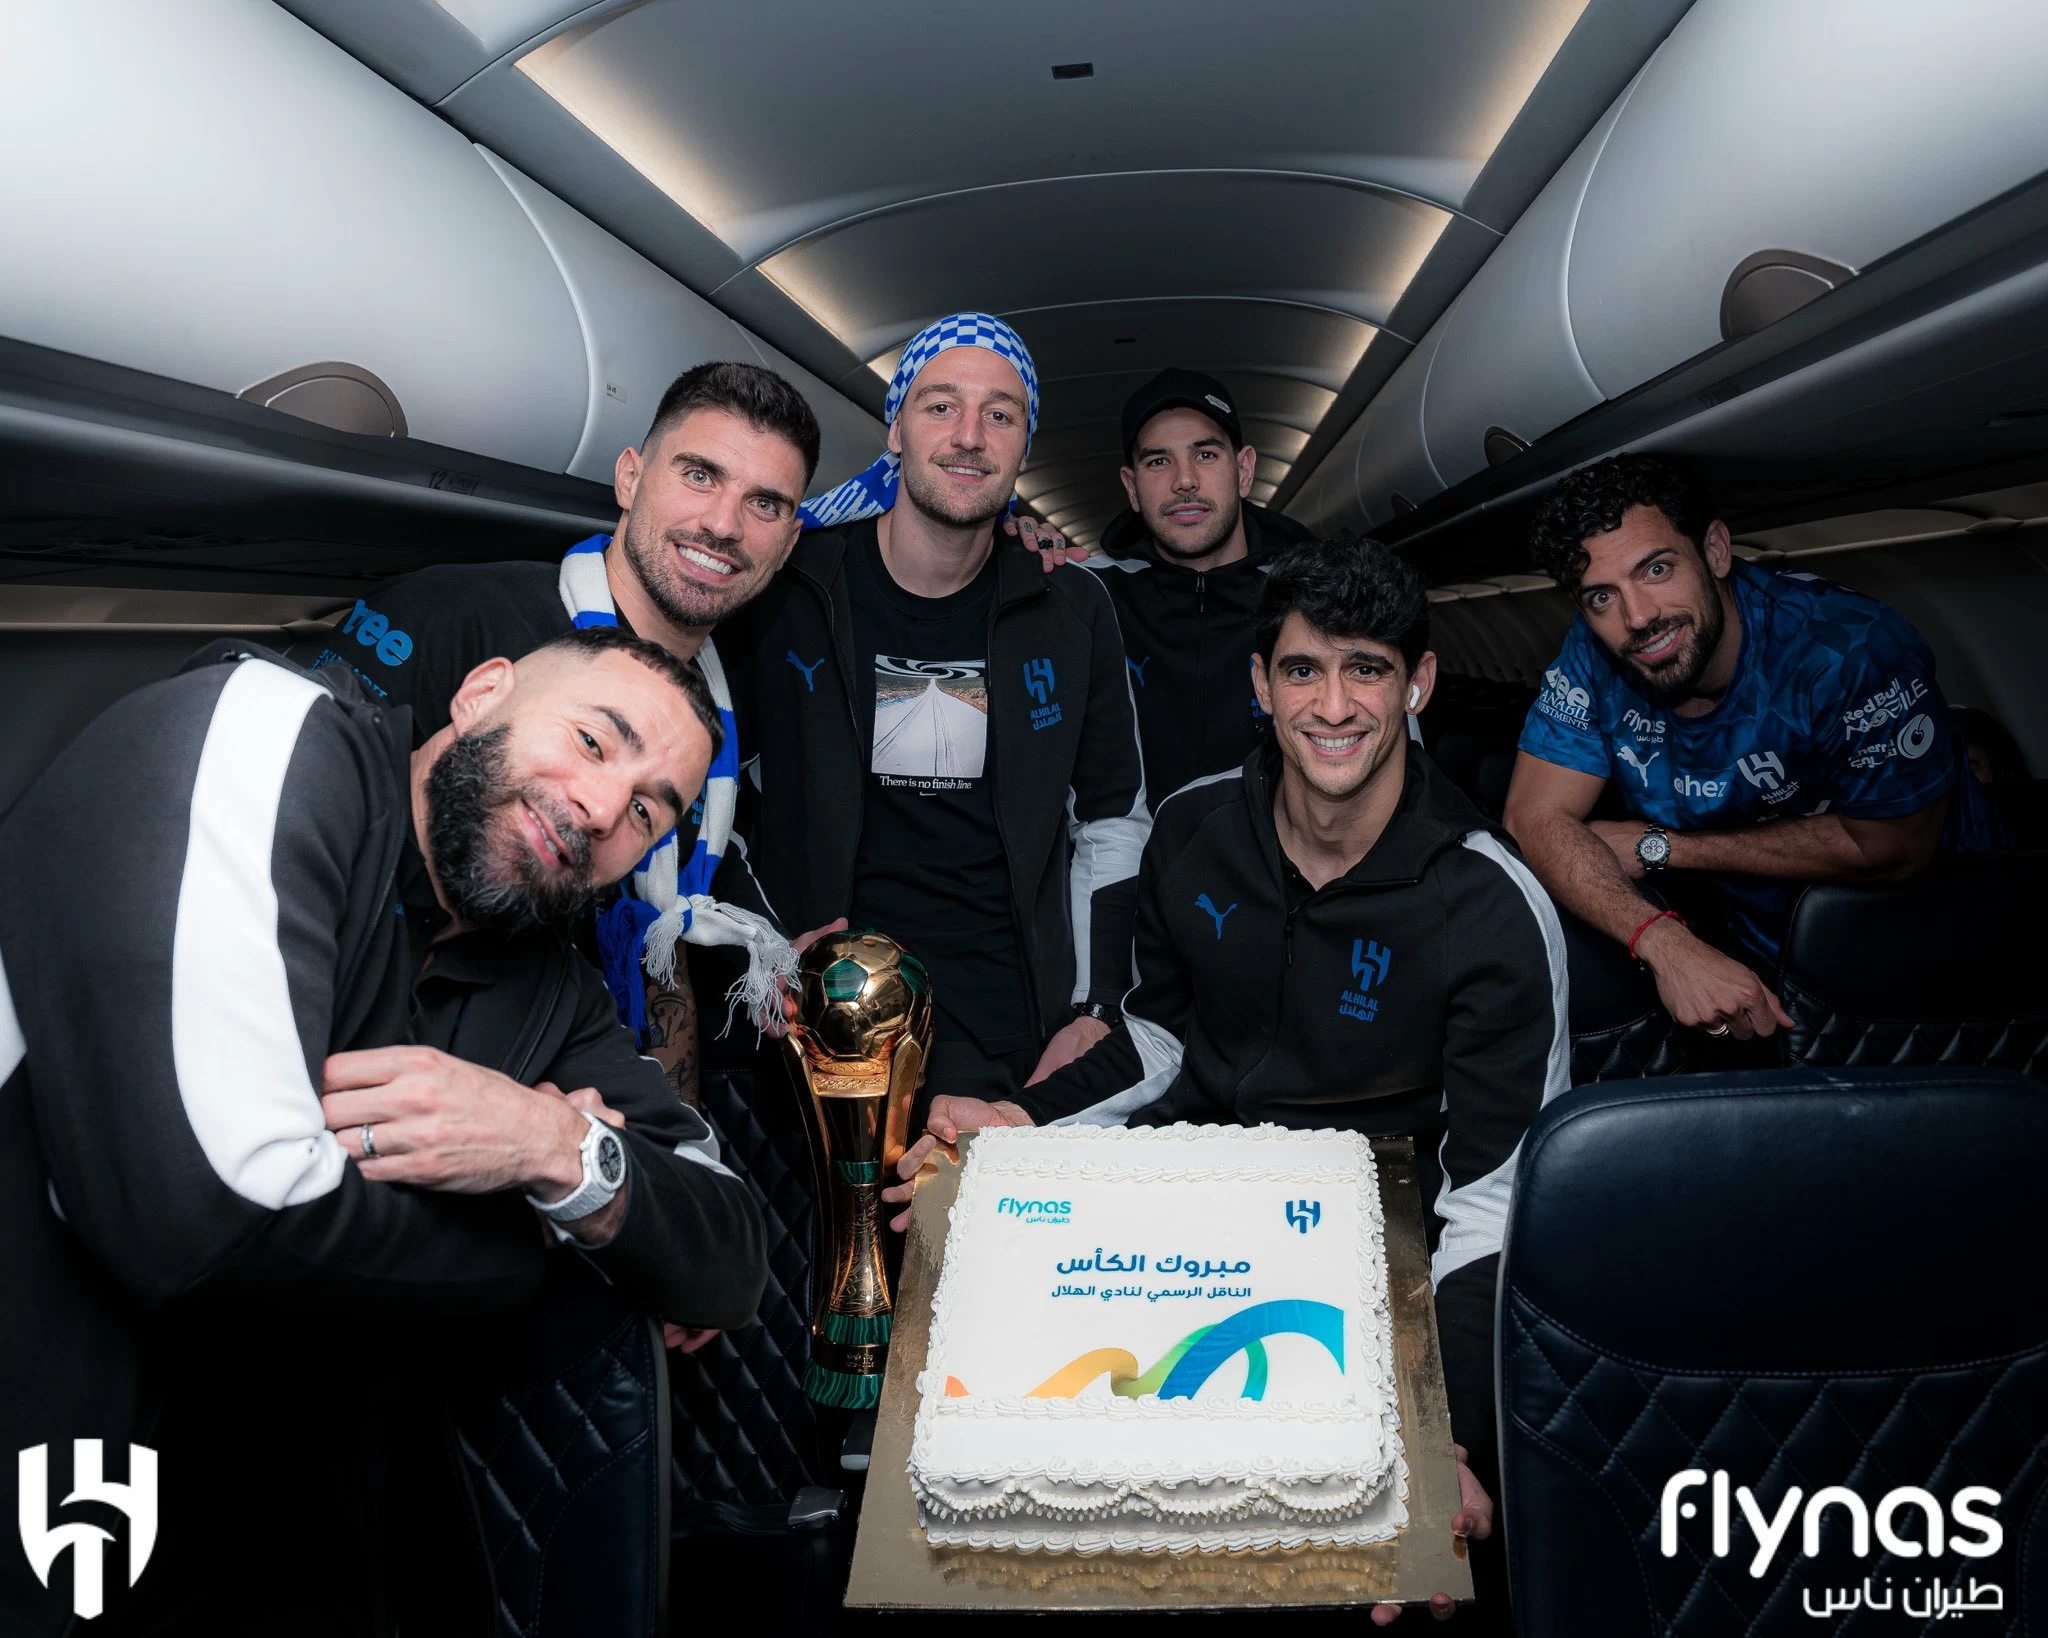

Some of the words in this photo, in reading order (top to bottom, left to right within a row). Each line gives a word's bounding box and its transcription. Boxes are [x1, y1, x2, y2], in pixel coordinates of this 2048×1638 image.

[1843, 698, 1877, 724] Red
[1874, 677, 1901, 707] Bull
[880, 775, 907, 786] There
[908, 778, 917, 787] is
[918, 780, 931, 789] no
[932, 778, 957, 790] finish
[1341, 989, 1379, 1012] ALHILAL
[997, 1197, 1072, 1218] flynas
[1056, 1247, 1146, 1275] الكأس
[1155, 1254, 1251, 1278] مبروك
[1051, 1285, 1096, 1298] الهلال
[1100, 1286, 1142, 1302] لنادي
[1146, 1286, 1202, 1303] الرسمي
[1206, 1286, 1251, 1299] الناقل
